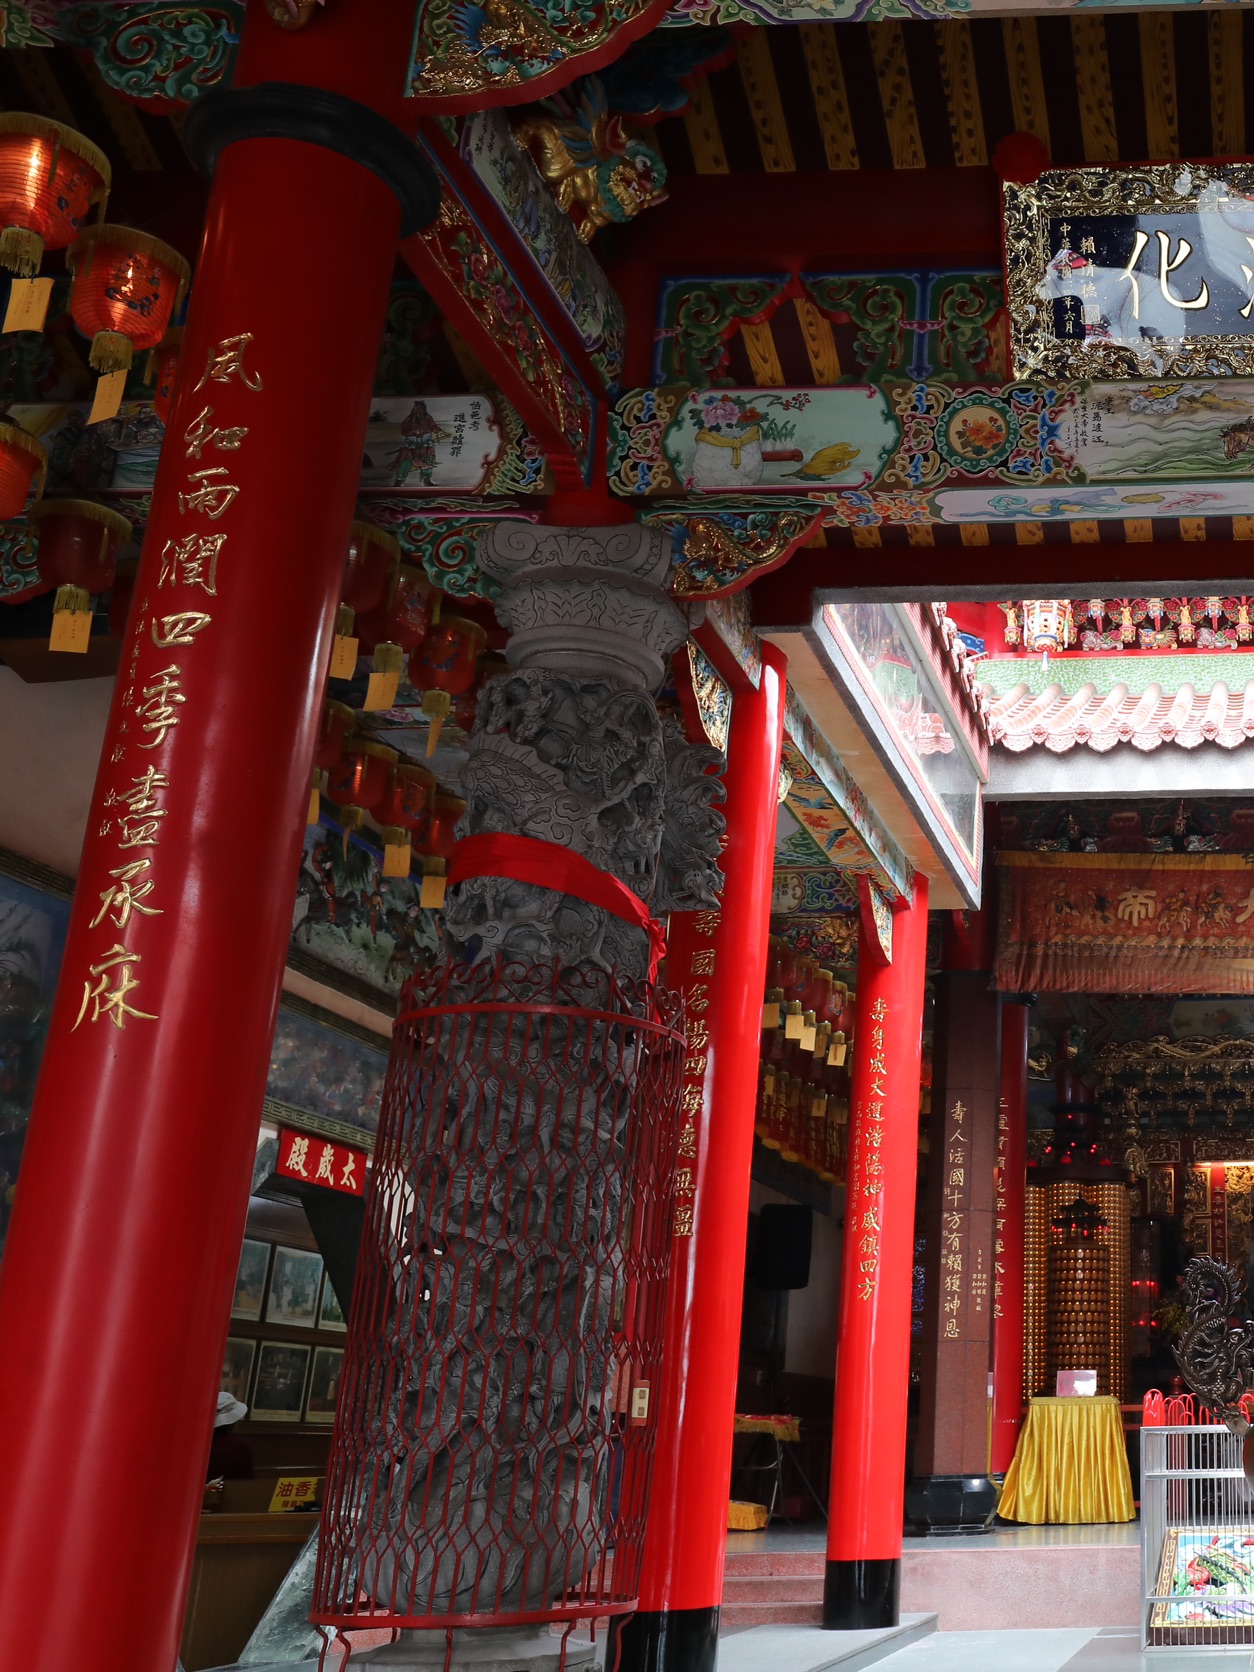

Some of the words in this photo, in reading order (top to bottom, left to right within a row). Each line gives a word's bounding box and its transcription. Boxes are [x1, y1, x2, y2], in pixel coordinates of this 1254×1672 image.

[450, 412, 467, 457] 進宮贖罪
[469, 401, 481, 431] 伯邑考
[285, 1136, 357, 1190] 太歲殿
